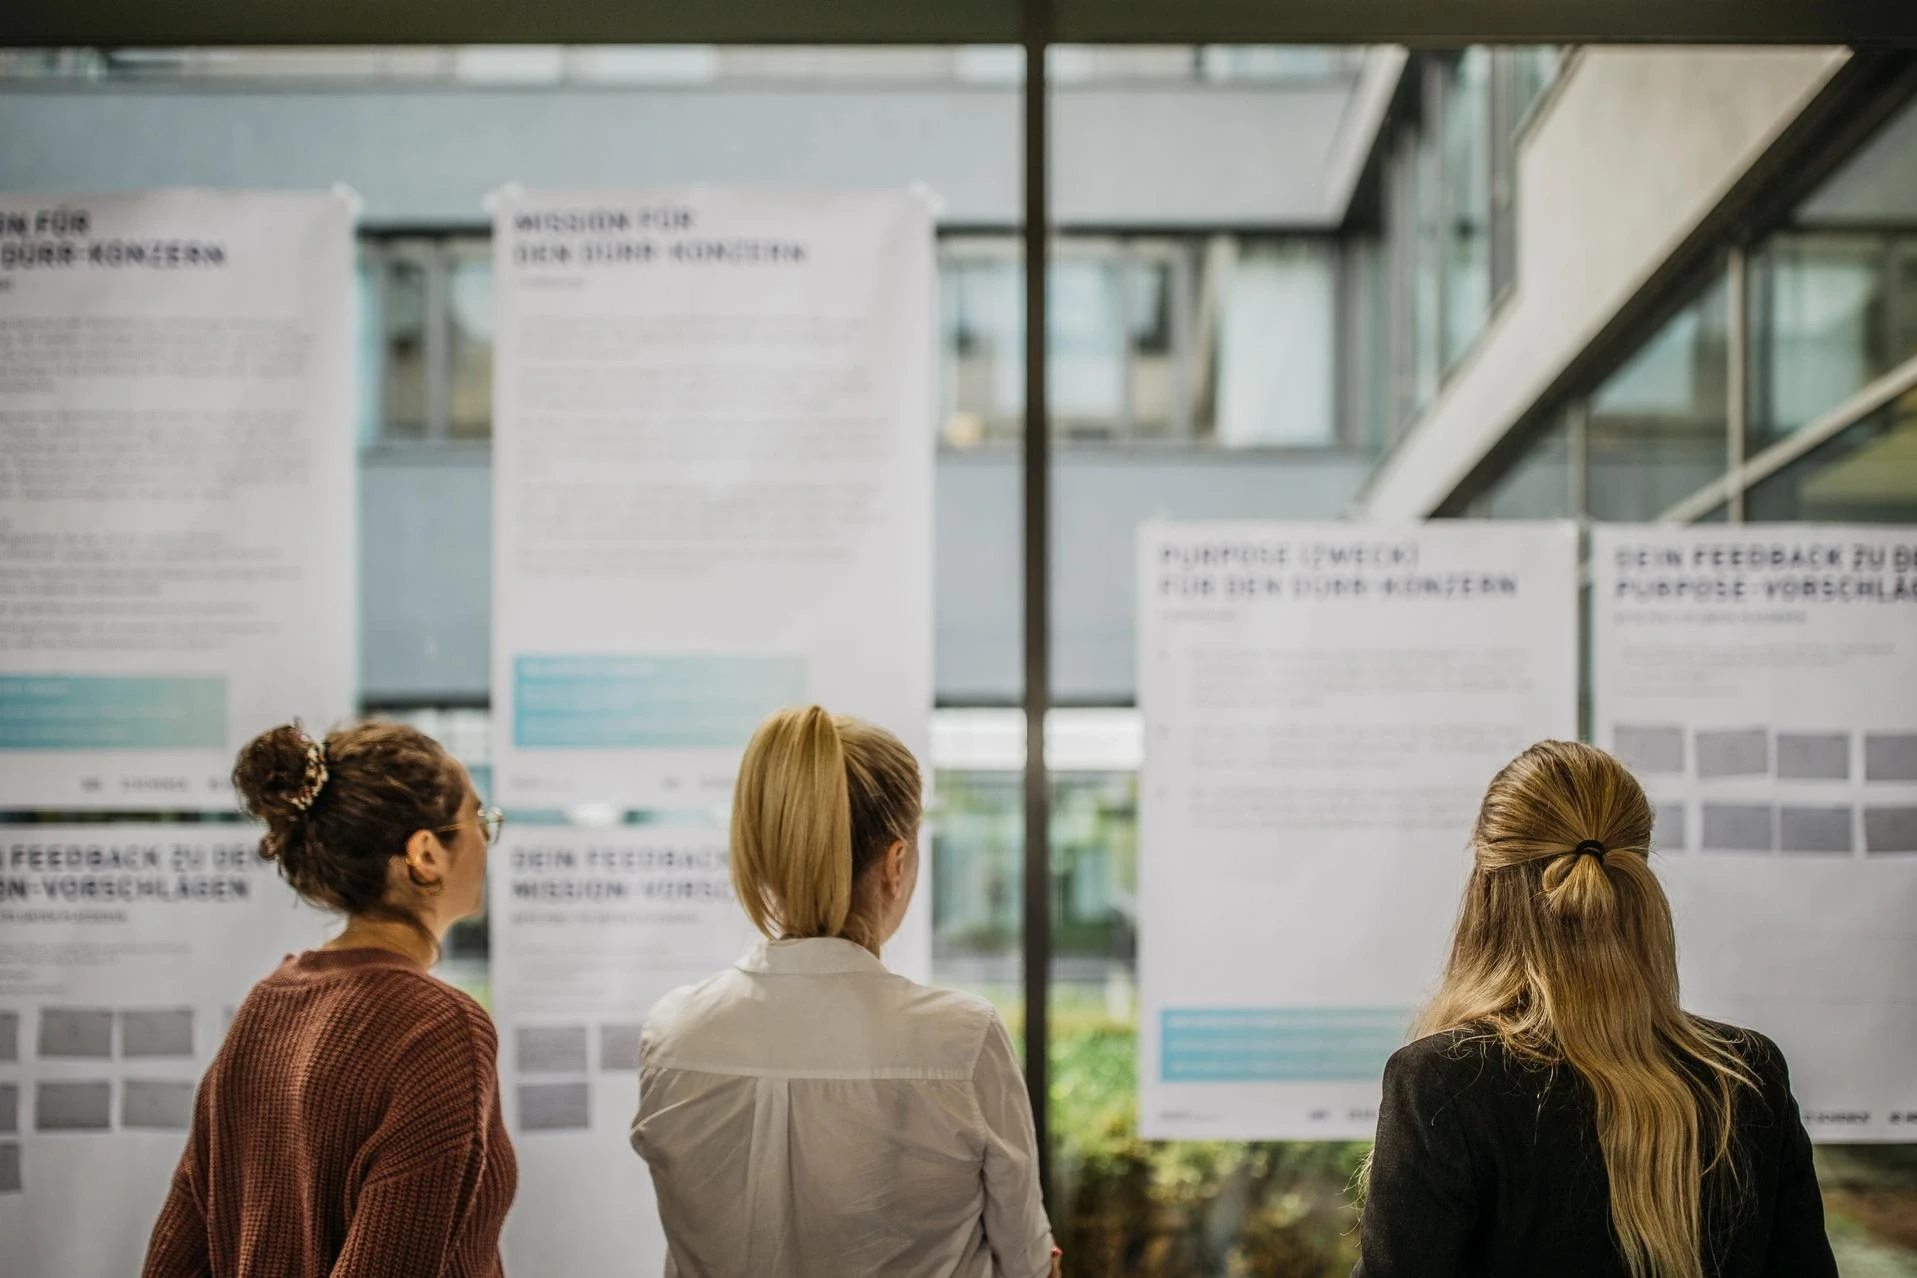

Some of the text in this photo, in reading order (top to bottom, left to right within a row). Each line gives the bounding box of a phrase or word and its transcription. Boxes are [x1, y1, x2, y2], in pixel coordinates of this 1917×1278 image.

[513, 209, 631, 234] MISSION
[1158, 541, 1287, 568] PURPOSE
[1615, 545, 1684, 570] DEIN
[1692, 544, 1841, 571] FEEDBACK
[1852, 544, 1886, 571] ZU
[8, 843, 160, 872] FEEDBACK
[512, 846, 577, 873] DEIN
